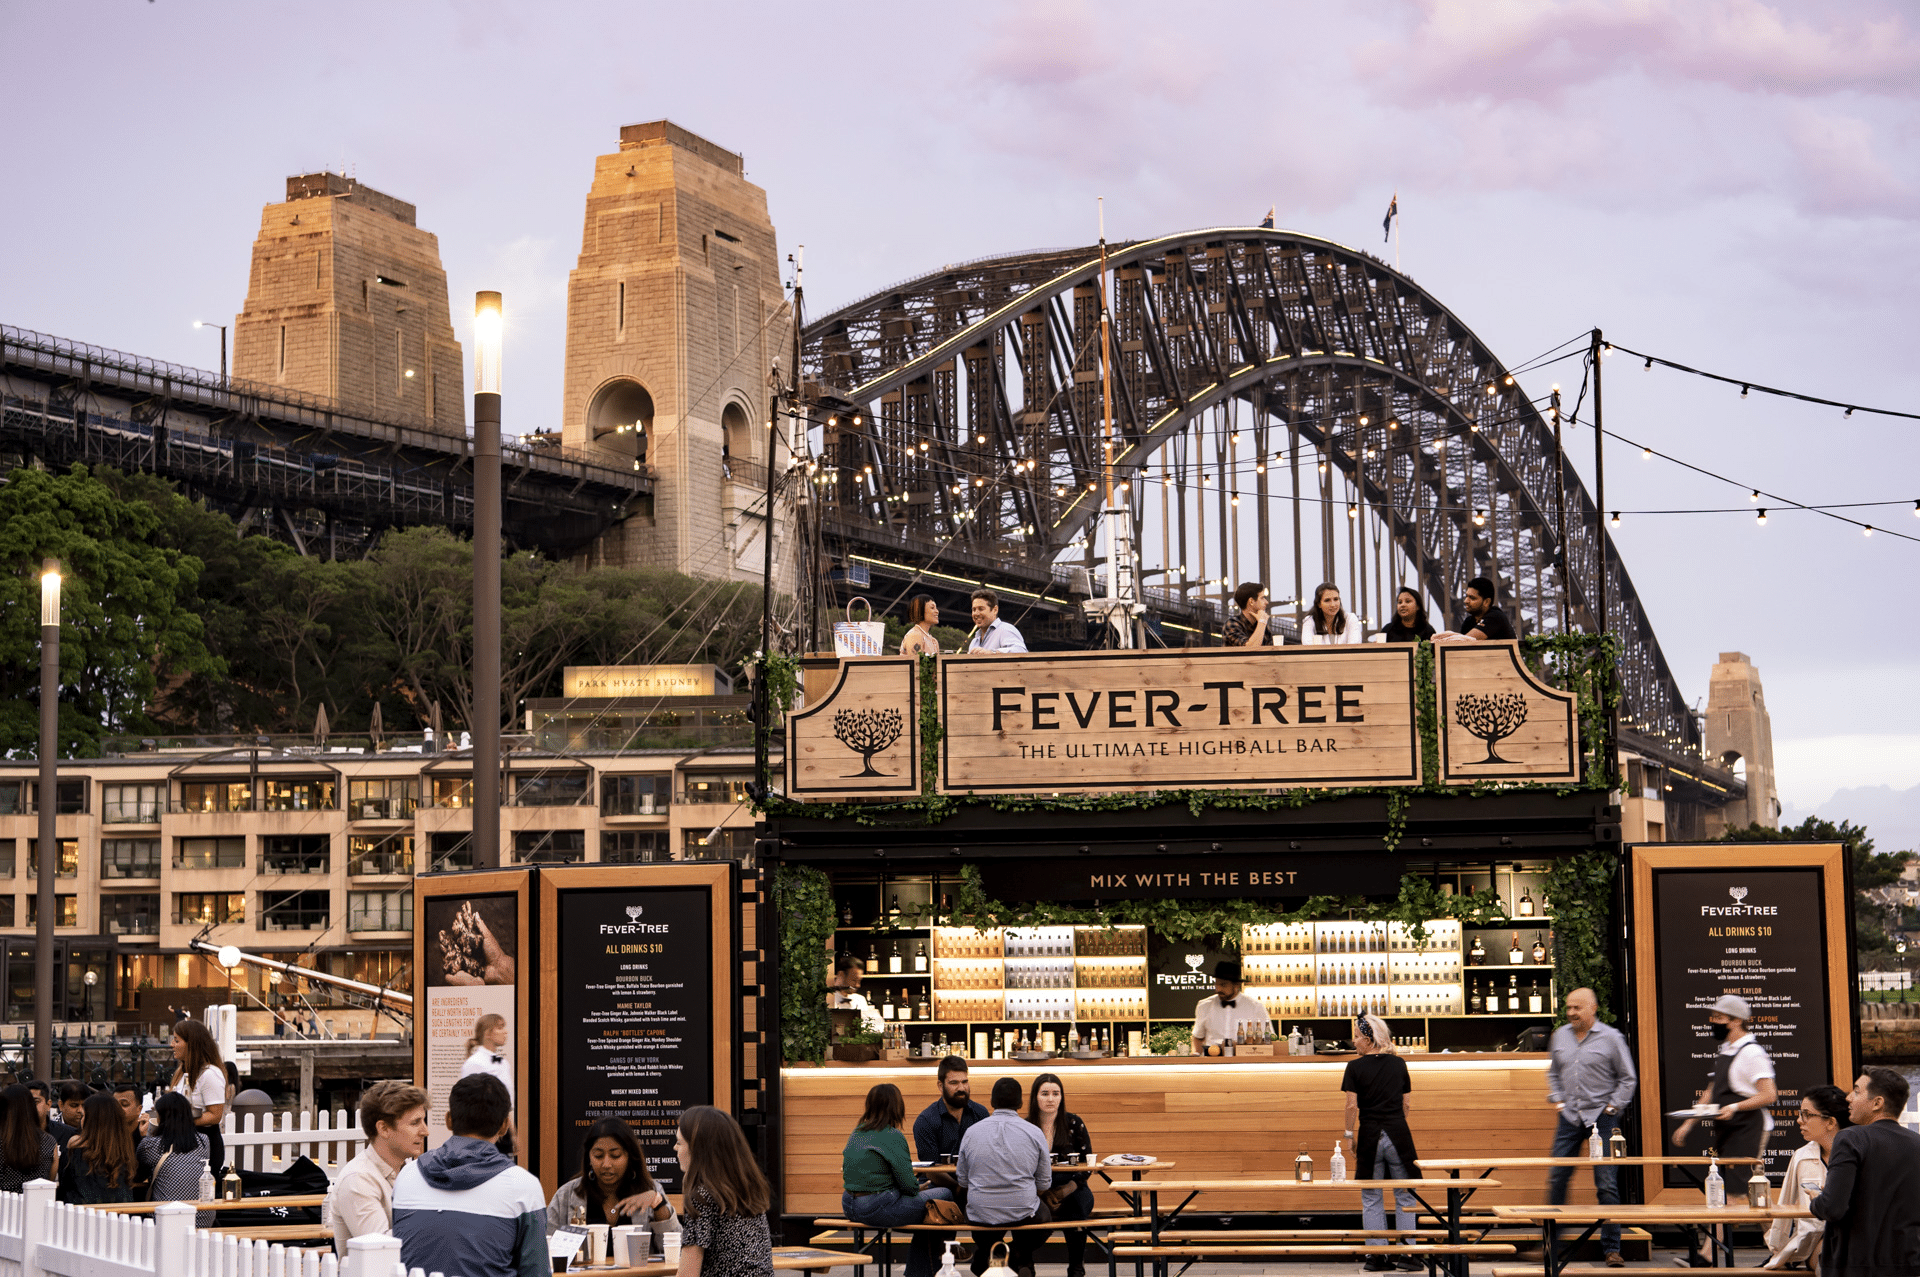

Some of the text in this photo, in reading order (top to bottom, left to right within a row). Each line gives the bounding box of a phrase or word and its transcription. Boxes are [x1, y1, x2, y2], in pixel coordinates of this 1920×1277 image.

[614, 679, 650, 687] HYATT
[992, 681, 1365, 731] FEVER-TREE
[1018, 738, 1338, 759] THE ULTIMATE HIGHBALL BAR
[1090, 872, 1298, 888] MIX WITH THE BEST
[1701, 905, 1778, 916] FEVER-TREE
[600, 924, 669, 934] FEVER-TREE
[1709, 926, 1772, 937] ALL DRINKS $10
[606, 944, 663, 954] ALL DRINKS $10
